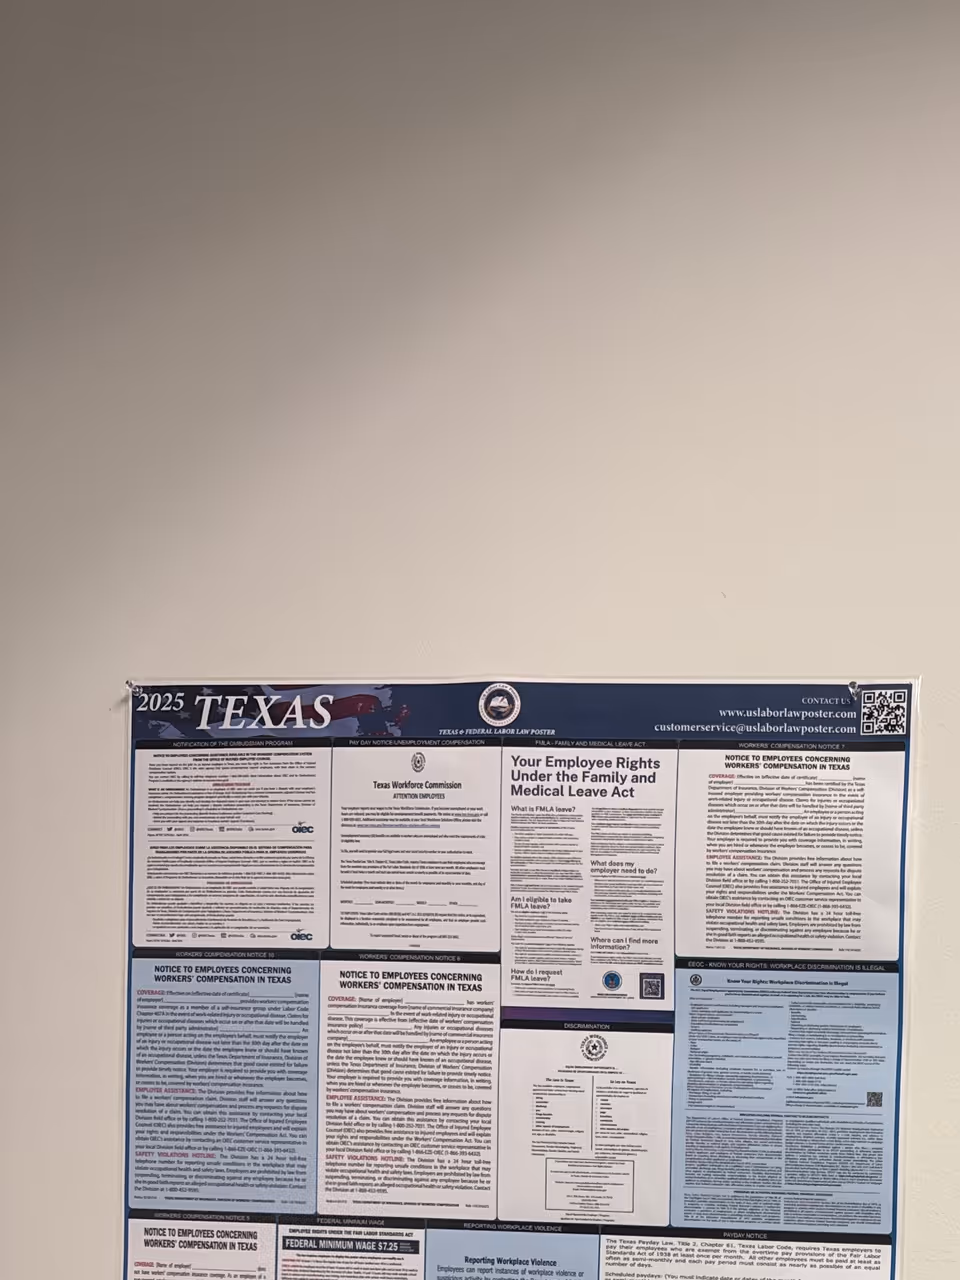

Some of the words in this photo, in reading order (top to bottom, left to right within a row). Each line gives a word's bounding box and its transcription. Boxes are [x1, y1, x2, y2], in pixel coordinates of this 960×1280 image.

[137, 691, 184, 712] 2025
[194, 694, 333, 730] TEXAS
[719, 708, 856, 719] www.uslaborlawposter.com
[654, 723, 856, 735] customerservice@uslaborlawposter.com
[511, 755, 542, 771] Your
[545, 755, 612, 771] Employee
[615, 756, 660, 772] Rights
[511, 769, 552, 782] Under
[555, 770, 578, 782] the
[582, 770, 627, 785] Family
[630, 771, 655, 783] and
[373, 780, 390, 789] Texas
[391, 780, 423, 789] Workforce
[424, 780, 461, 789] Commission
[511, 784, 564, 796] Medical
[568, 785, 607, 797] Leave
[611, 786, 634, 797] Act
[154, 965, 181, 973] NOTICE
[183, 965, 193, 973] TO
[194, 965, 239, 973] EMPLOYEES
[241, 966, 291, 974] CONCERNING
[339, 970, 367, 978] NOTICE
[369, 971, 380, 979] TO
[381, 971, 428, 980] EMPLOYEES
[430, 972, 482, 981] CONCERNING
[154, 974, 194, 982] WORKERS'
[196, 975, 255, 983] COMPENSATION
[339, 980, 381, 989] WORKERS'
[383, 981, 444, 990] COMPENSATION
[457, 983, 482, 992] TEXAS
[285, 1238, 317, 1248] FEDERAL
[318, 1239, 353, 1249] MINIMUM
[355, 1241, 376, 1250] WAGE
[377, 1241, 398, 1251] $7.25
[464, 1255, 495, 1266] Reporting
[496, 1257, 529, 1266] Workplace
[530, 1258, 557, 1266] Violence
